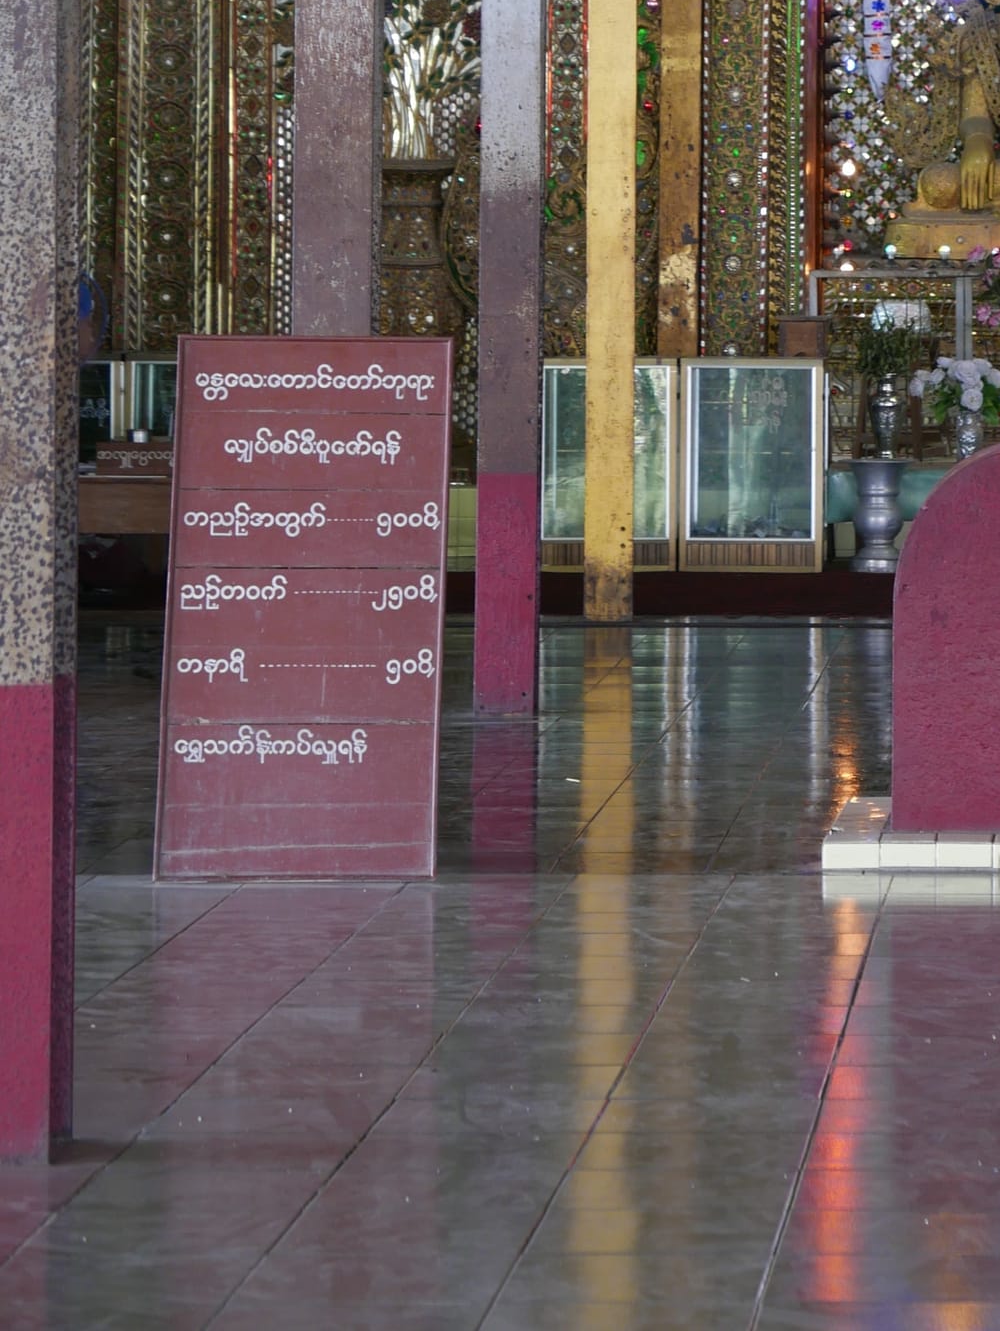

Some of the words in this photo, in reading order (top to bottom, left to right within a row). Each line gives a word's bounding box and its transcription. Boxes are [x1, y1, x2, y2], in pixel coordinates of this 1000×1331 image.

[195, 364, 435, 400] မန္တလေးတောင်တော်ဘုရား
[224, 427, 401, 464] လျှပ်စစ်မီးပူဇော်ရန်
